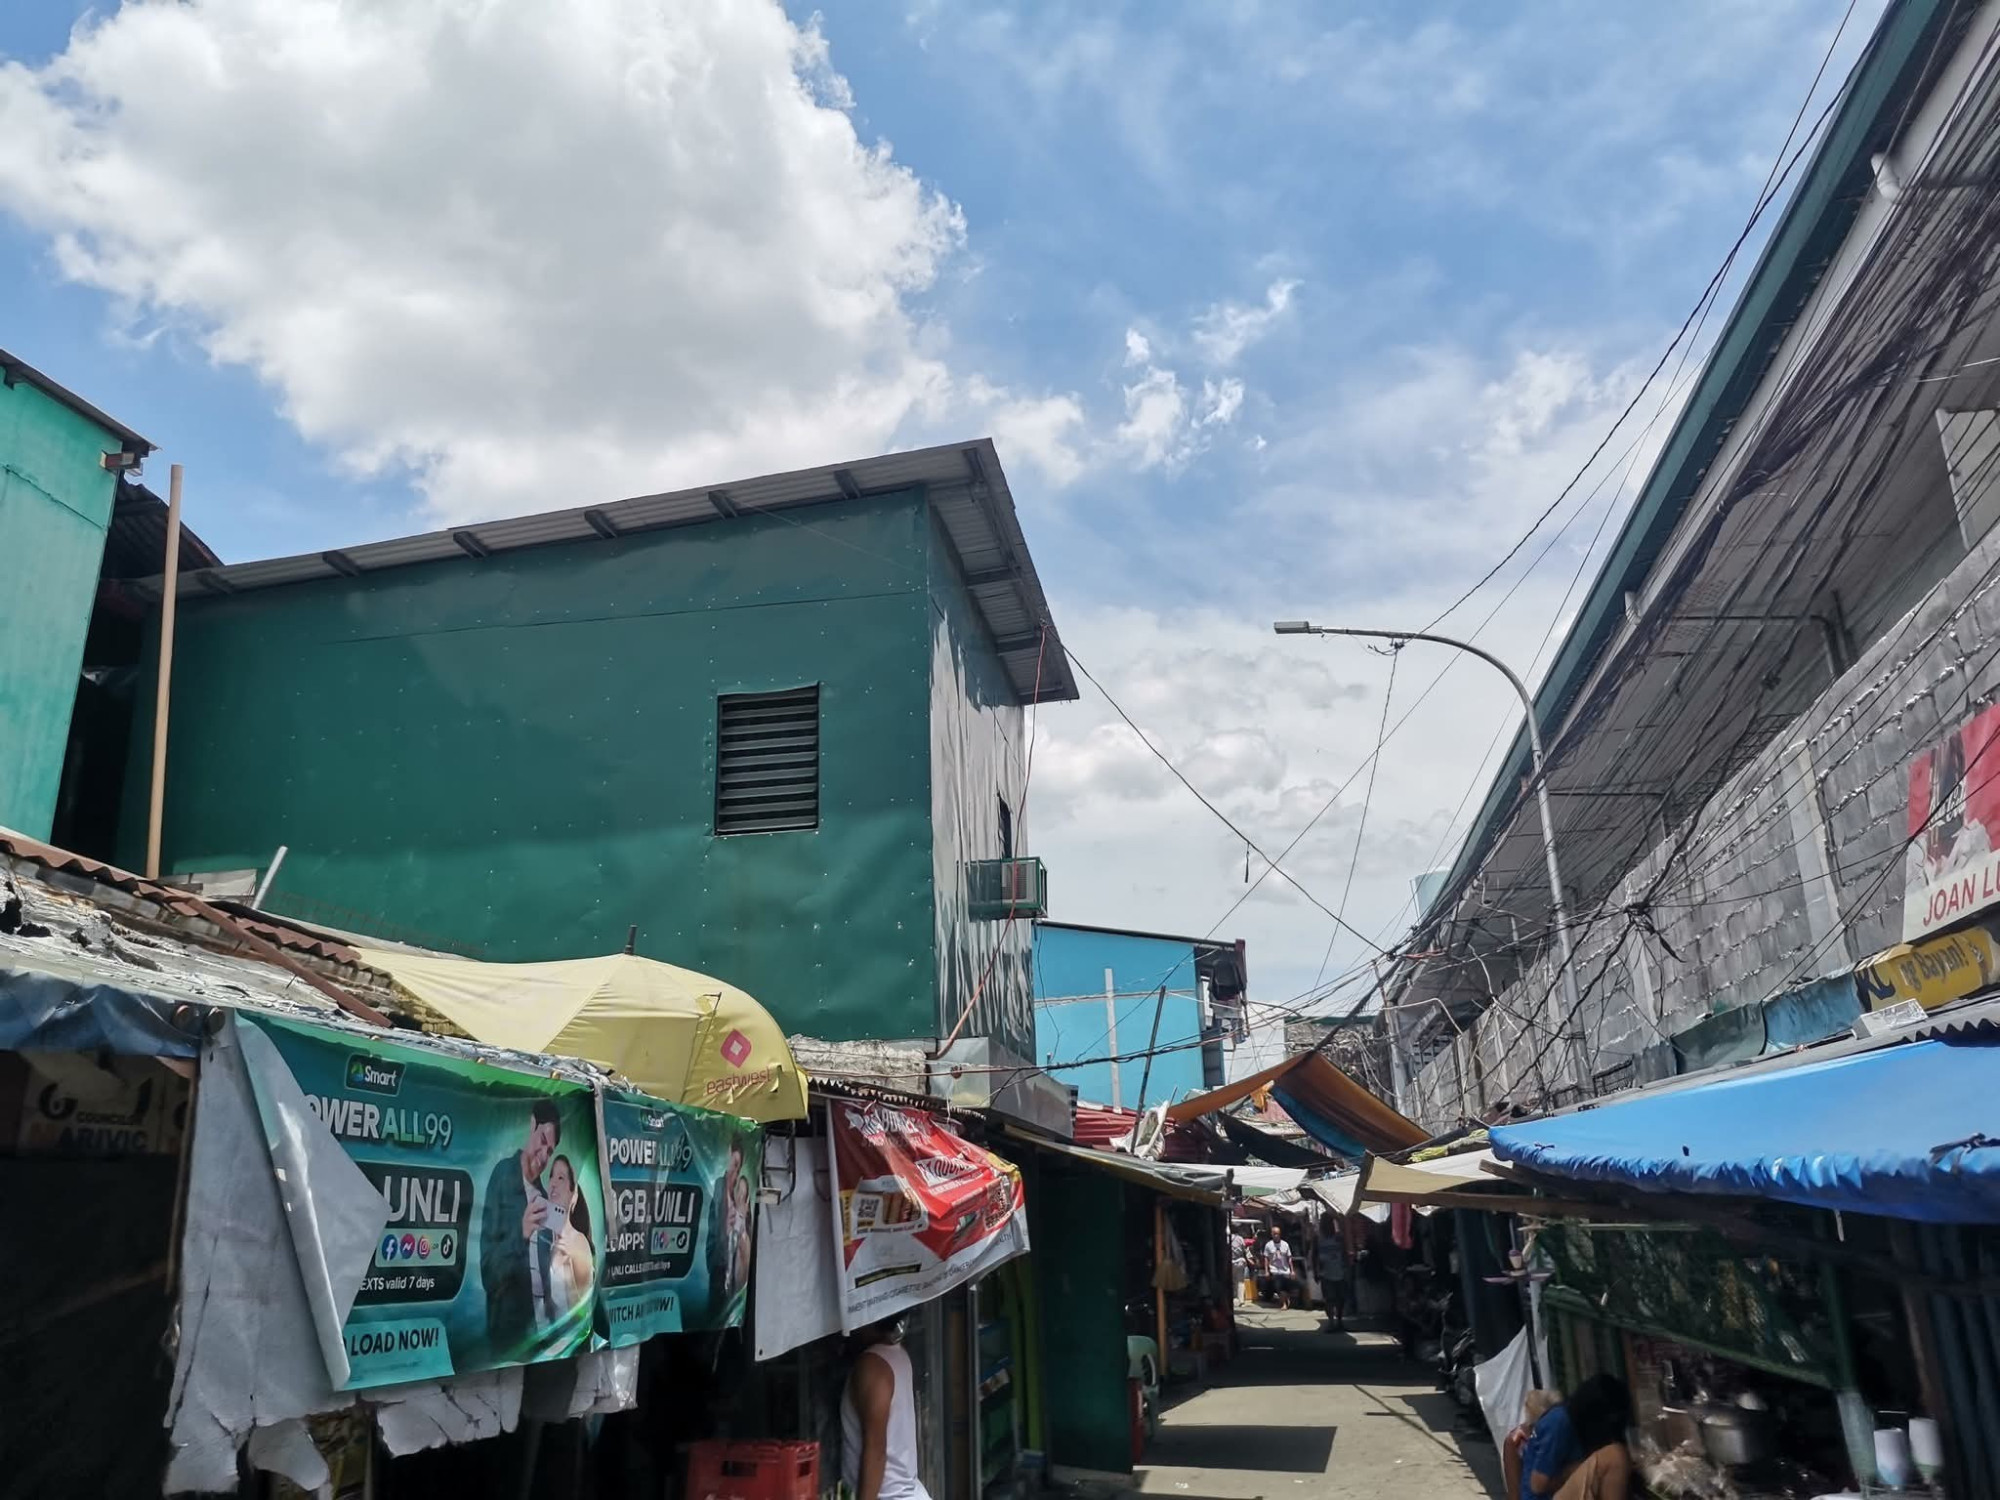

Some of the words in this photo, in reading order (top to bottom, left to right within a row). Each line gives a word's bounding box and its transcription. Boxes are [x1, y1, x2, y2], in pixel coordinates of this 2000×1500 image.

[1923, 873, 1977, 928] JOAN
[1913, 938, 1970, 984] Bayan!
[364, 1065, 398, 1087] Smart
[304, 1093, 453, 1146] OWERALL99
[383, 1175, 461, 1223] UNLI
[654, 1189, 696, 1224] UNLI
[618, 1231, 646, 1251] APPS
[360, 1277, 385, 1291] EXTS
[386, 1276, 407, 1290] valid
[408, 1275, 415, 1289] 7
[416, 1276, 435, 1291] days
[350, 1330, 395, 1356] LOAD
[399, 1327, 440, 1350] NOW!
